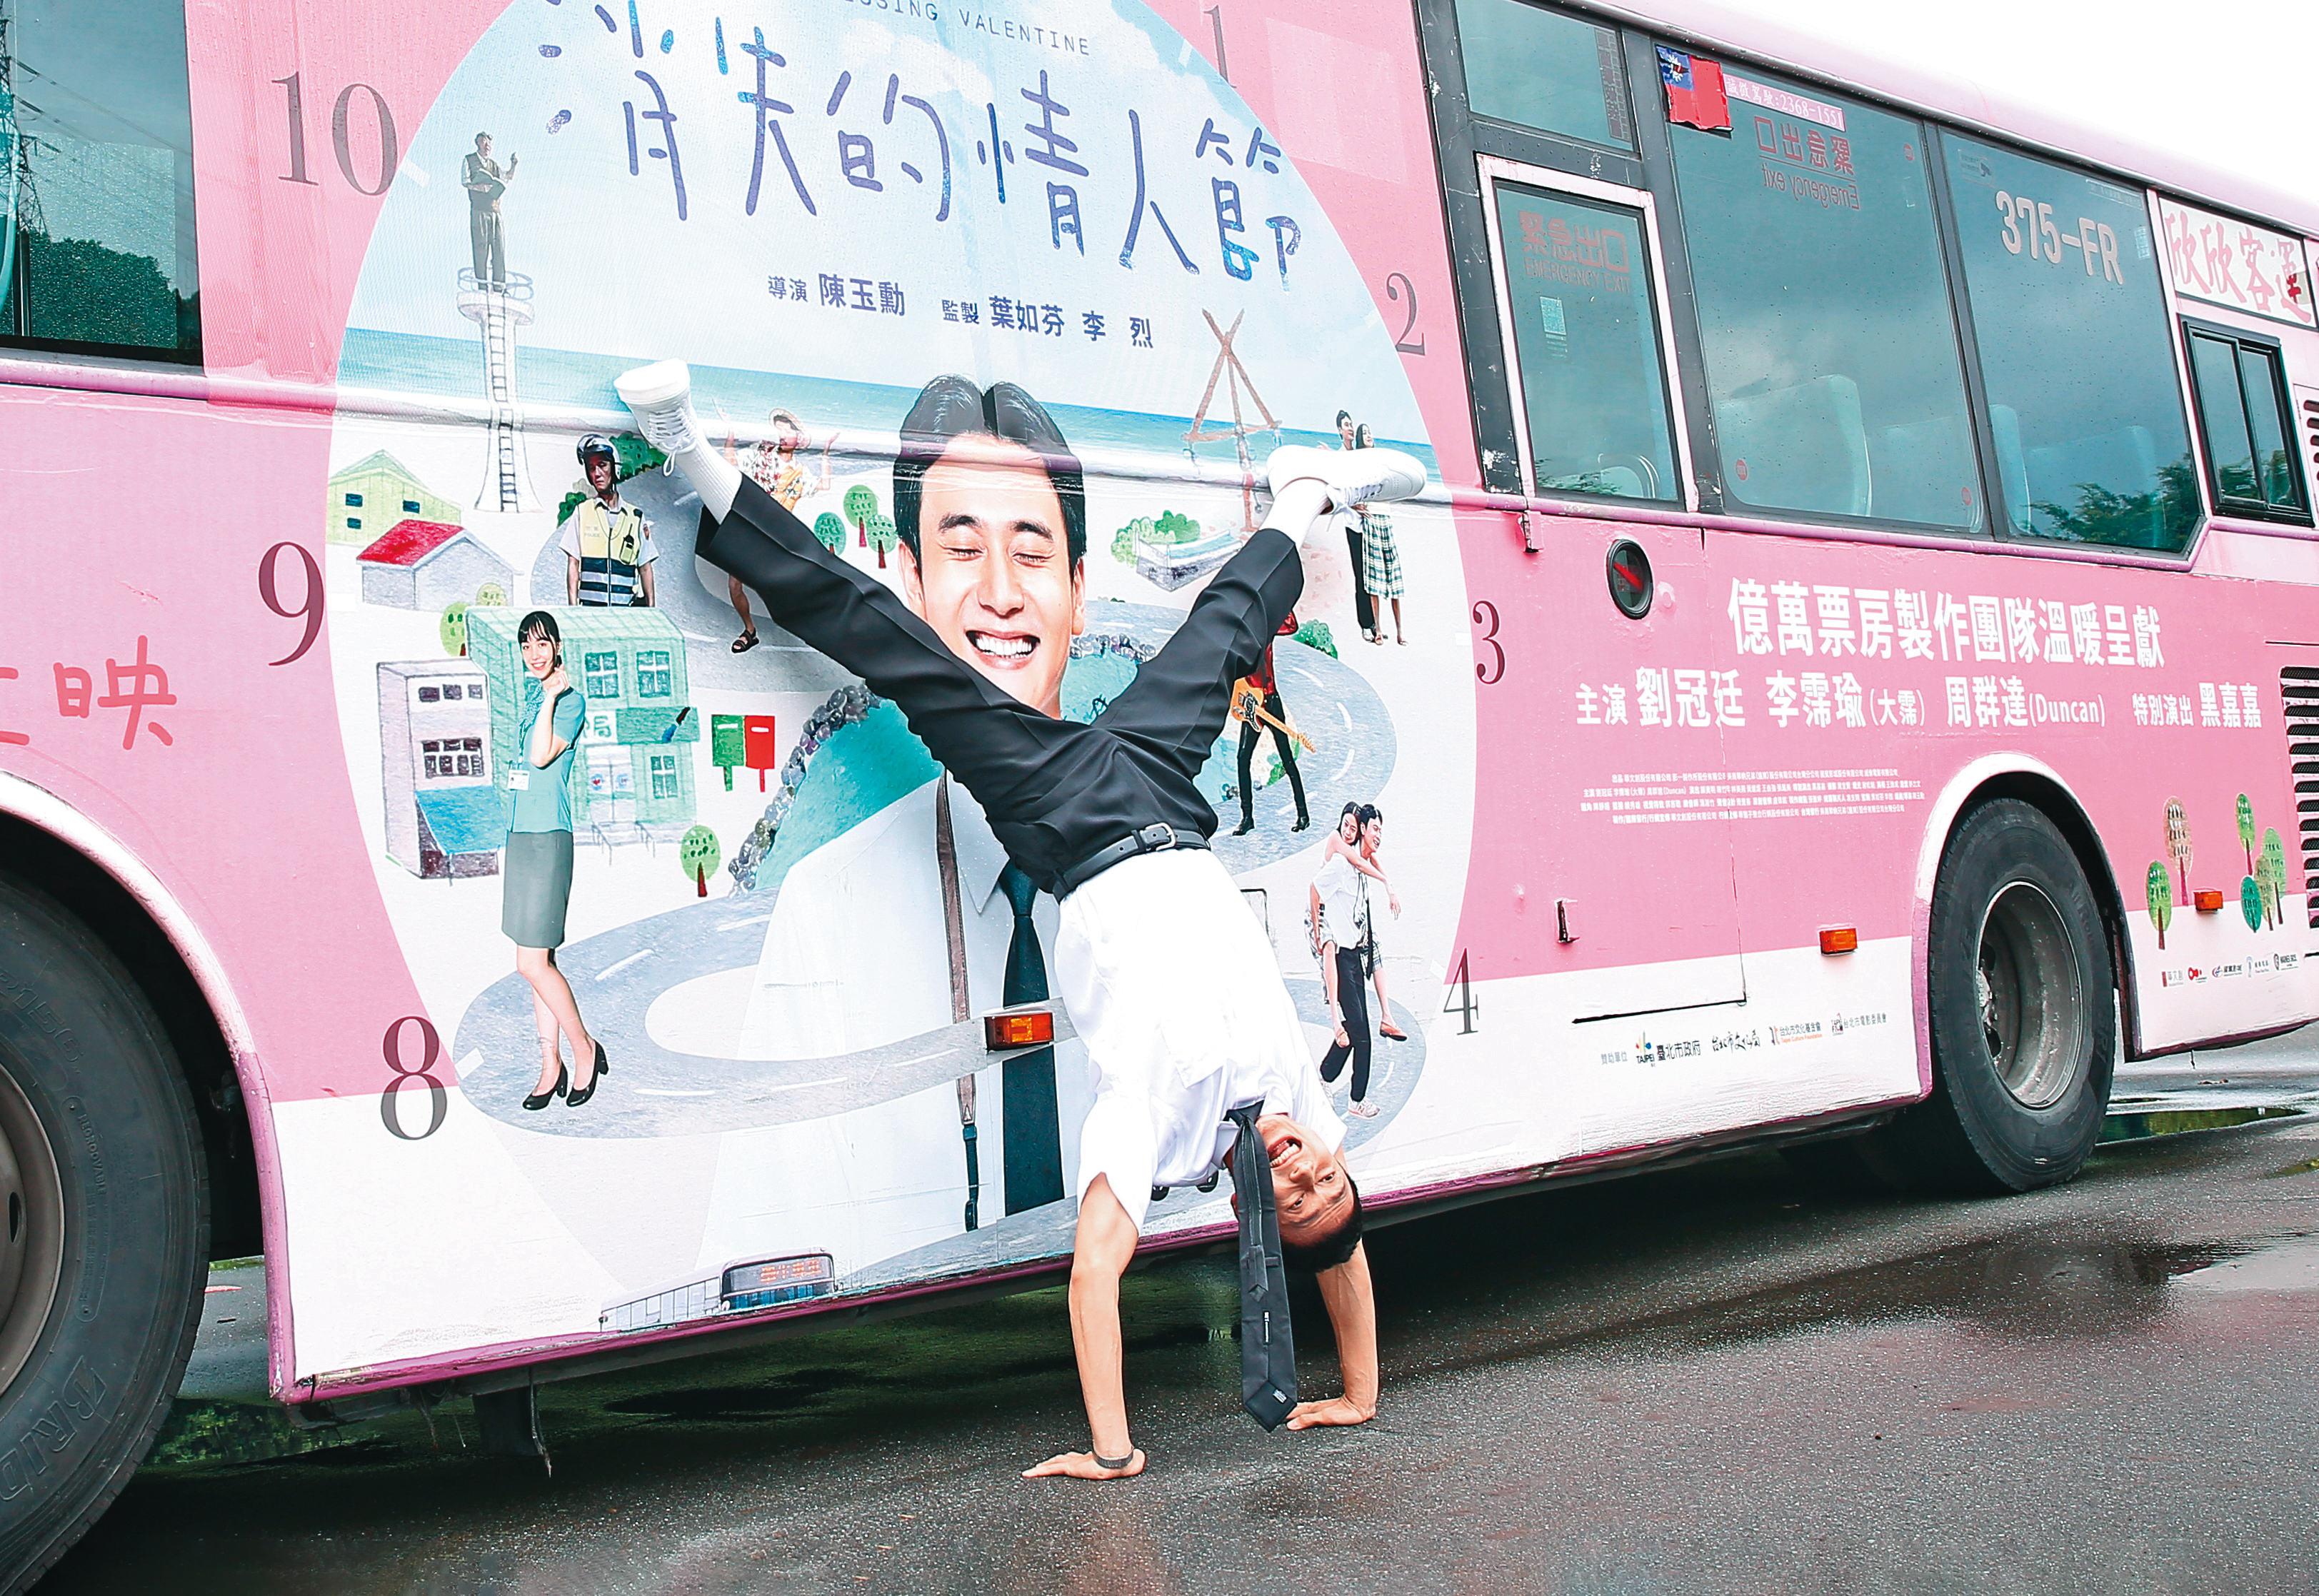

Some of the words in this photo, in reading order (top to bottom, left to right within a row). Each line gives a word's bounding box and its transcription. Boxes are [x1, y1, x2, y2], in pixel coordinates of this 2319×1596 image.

[958, 8, 1090, 56] VALENTINE
[271, 71, 399, 196] 10
[538, 0, 1303, 293] 消失的情人節
[1517, 210, 1630, 274] 緊急出口
[1523, 256, 1600, 290] EMERGENCY
[1603, 271, 1631, 293] EXIT
[1995, 190, 2124, 285] 375-FR
[2164, 210, 2312, 324] 欣欣客運
[768, 275, 808, 303] 導演
[818, 273, 906, 317] 陳玉勳
[941, 298, 981, 325] 監製
[988, 295, 1066, 337] 葉如芬
[1386, 272, 1426, 356] 2
[258, 541, 325, 667] 9
[1472, 600, 1506, 685] 3
[1727, 576, 2165, 668] 億萬票房製作團隊溫暖呈獻
[1575, 683, 1629, 726] 主演
[1636, 666, 1746, 728] 劉冠廷
[2132, 693, 2195, 728] 特別演出
[2198, 681, 2263, 728] 黑嘉嘉
[1443, 947, 1479, 1035] 4
[380, 1015, 448, 1140] 8
[1636, 1053, 1656, 1064] TAIPEI
[1656, 1040, 1701, 1061] 臺北市政府
